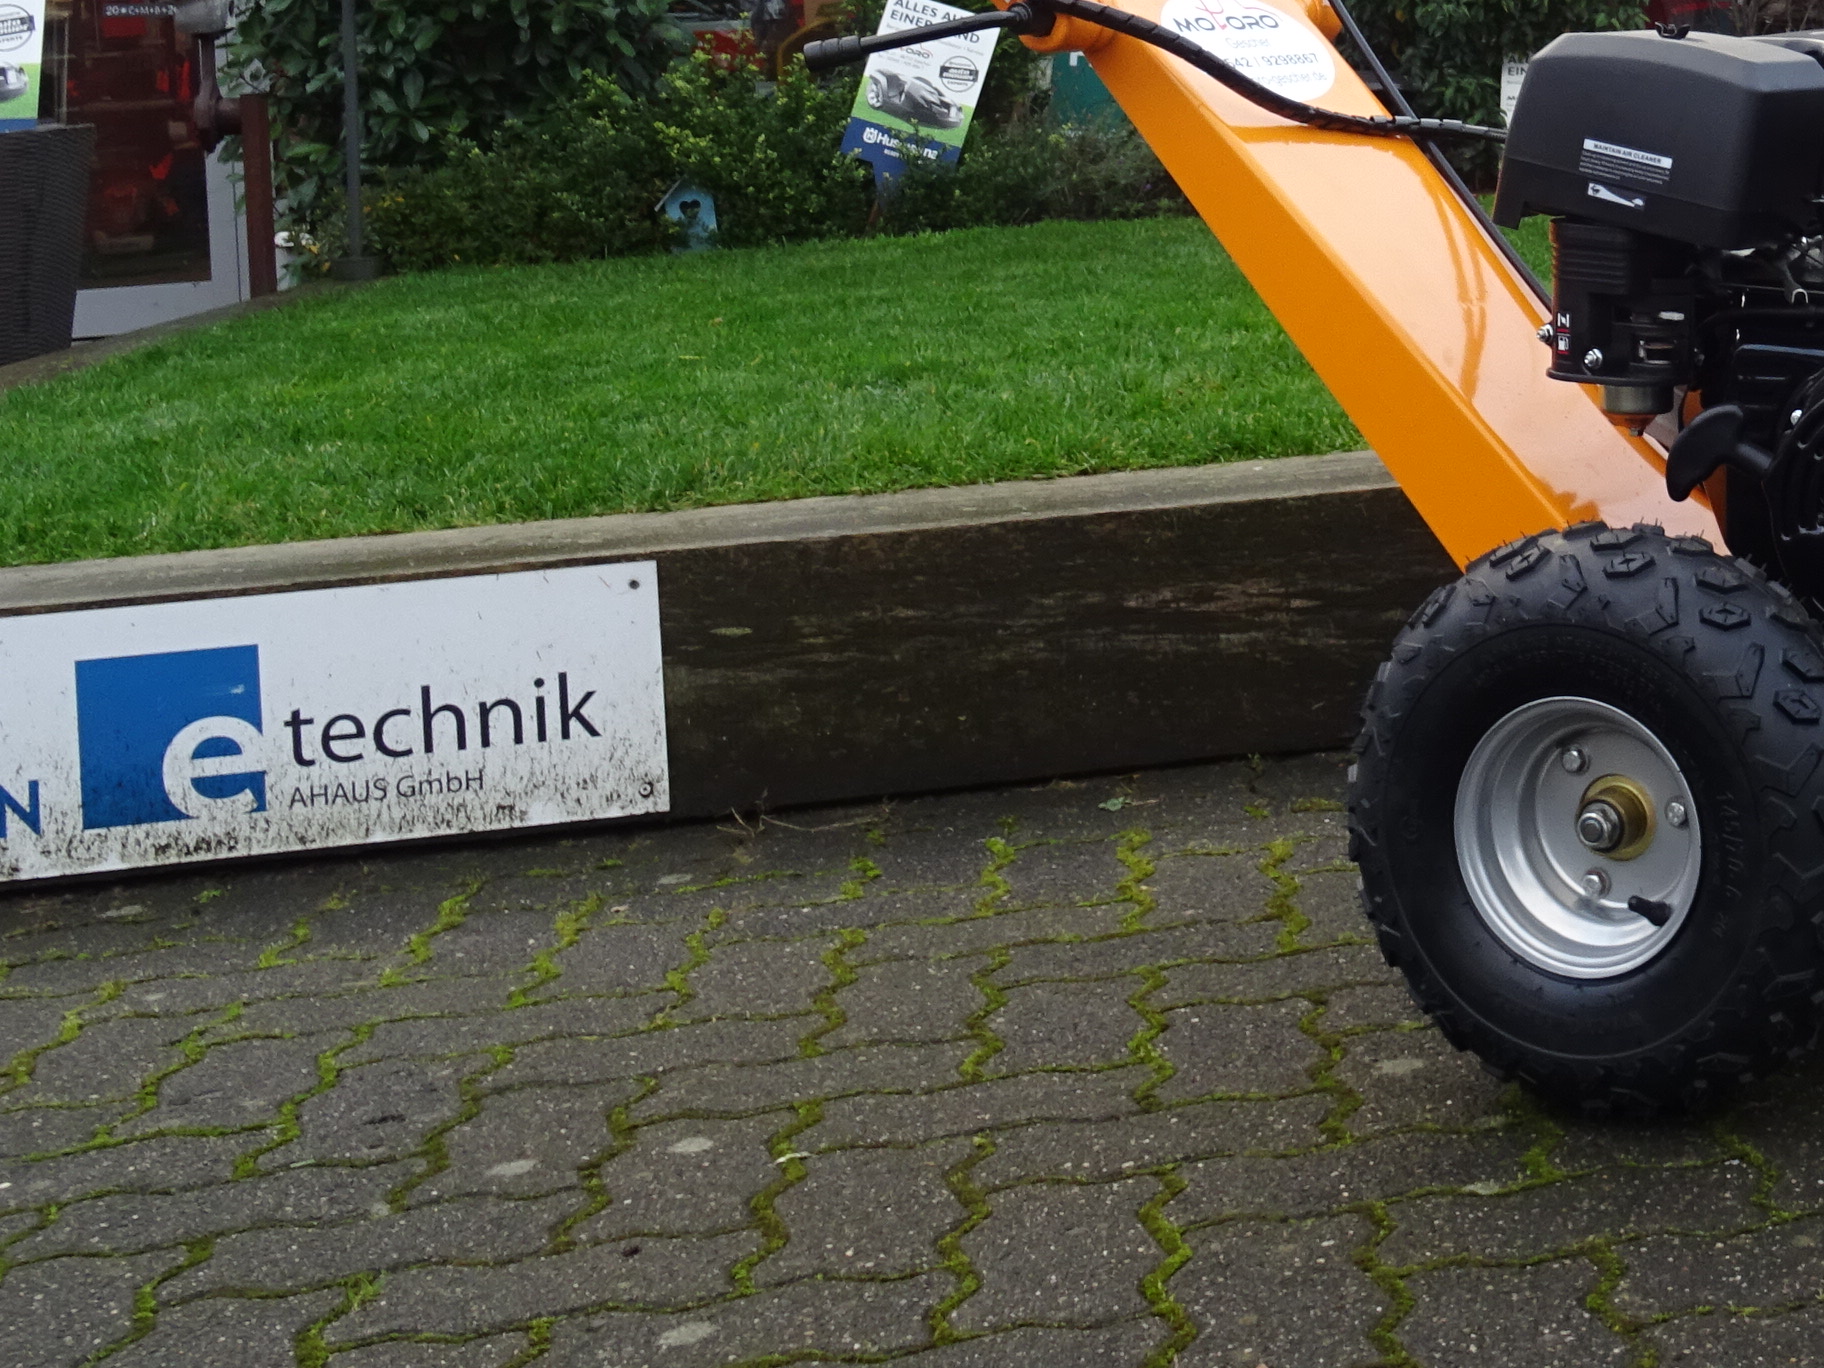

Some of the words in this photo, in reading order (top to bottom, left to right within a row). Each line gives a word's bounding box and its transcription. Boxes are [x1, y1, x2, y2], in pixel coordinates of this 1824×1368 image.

[1262, 53, 1320, 67] 9298867
[1594, 143, 1622, 156] MAINTAIN
[1622, 150, 1632, 158] AIR
[1633, 152, 1662, 165] CLEANER
[283, 671, 602, 768] technik
[289, 776, 388, 809] AHAUS
[395, 768, 485, 799] GmbH
